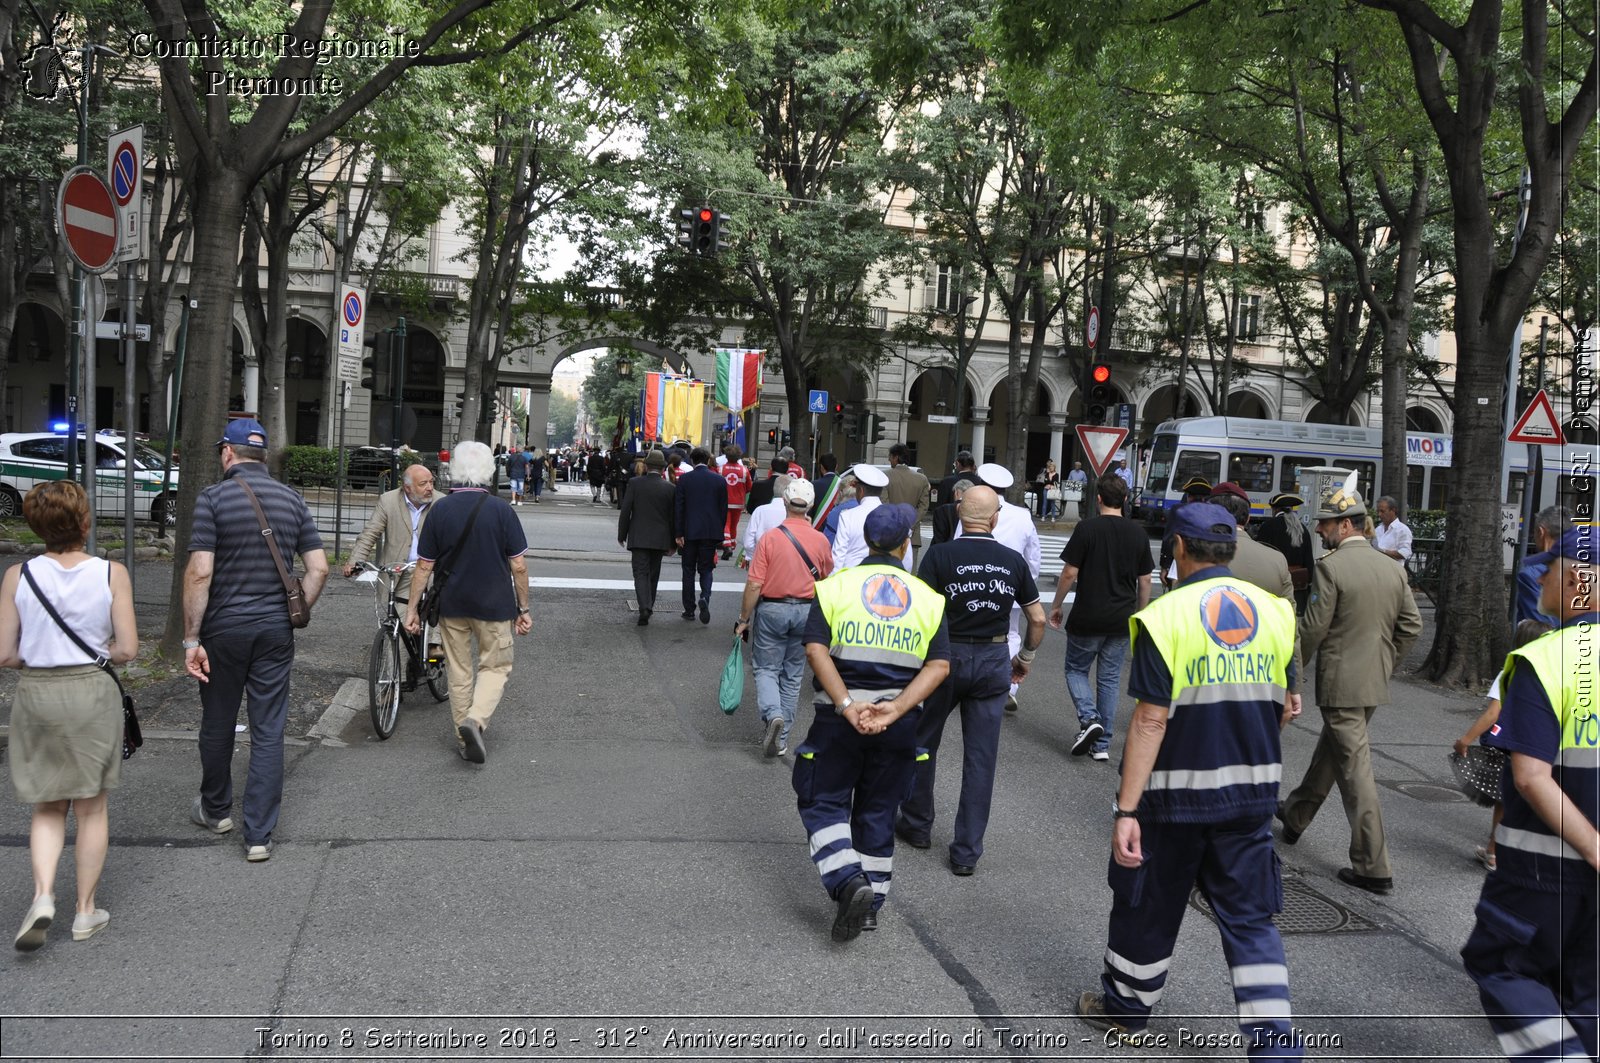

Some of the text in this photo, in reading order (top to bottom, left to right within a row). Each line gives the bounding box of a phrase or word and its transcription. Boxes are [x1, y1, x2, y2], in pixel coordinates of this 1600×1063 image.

[956, 563, 1011, 576] Gruppo Storico
[944, 581, 985, 600] Pietro
[966, 599, 1000, 612] Torino
